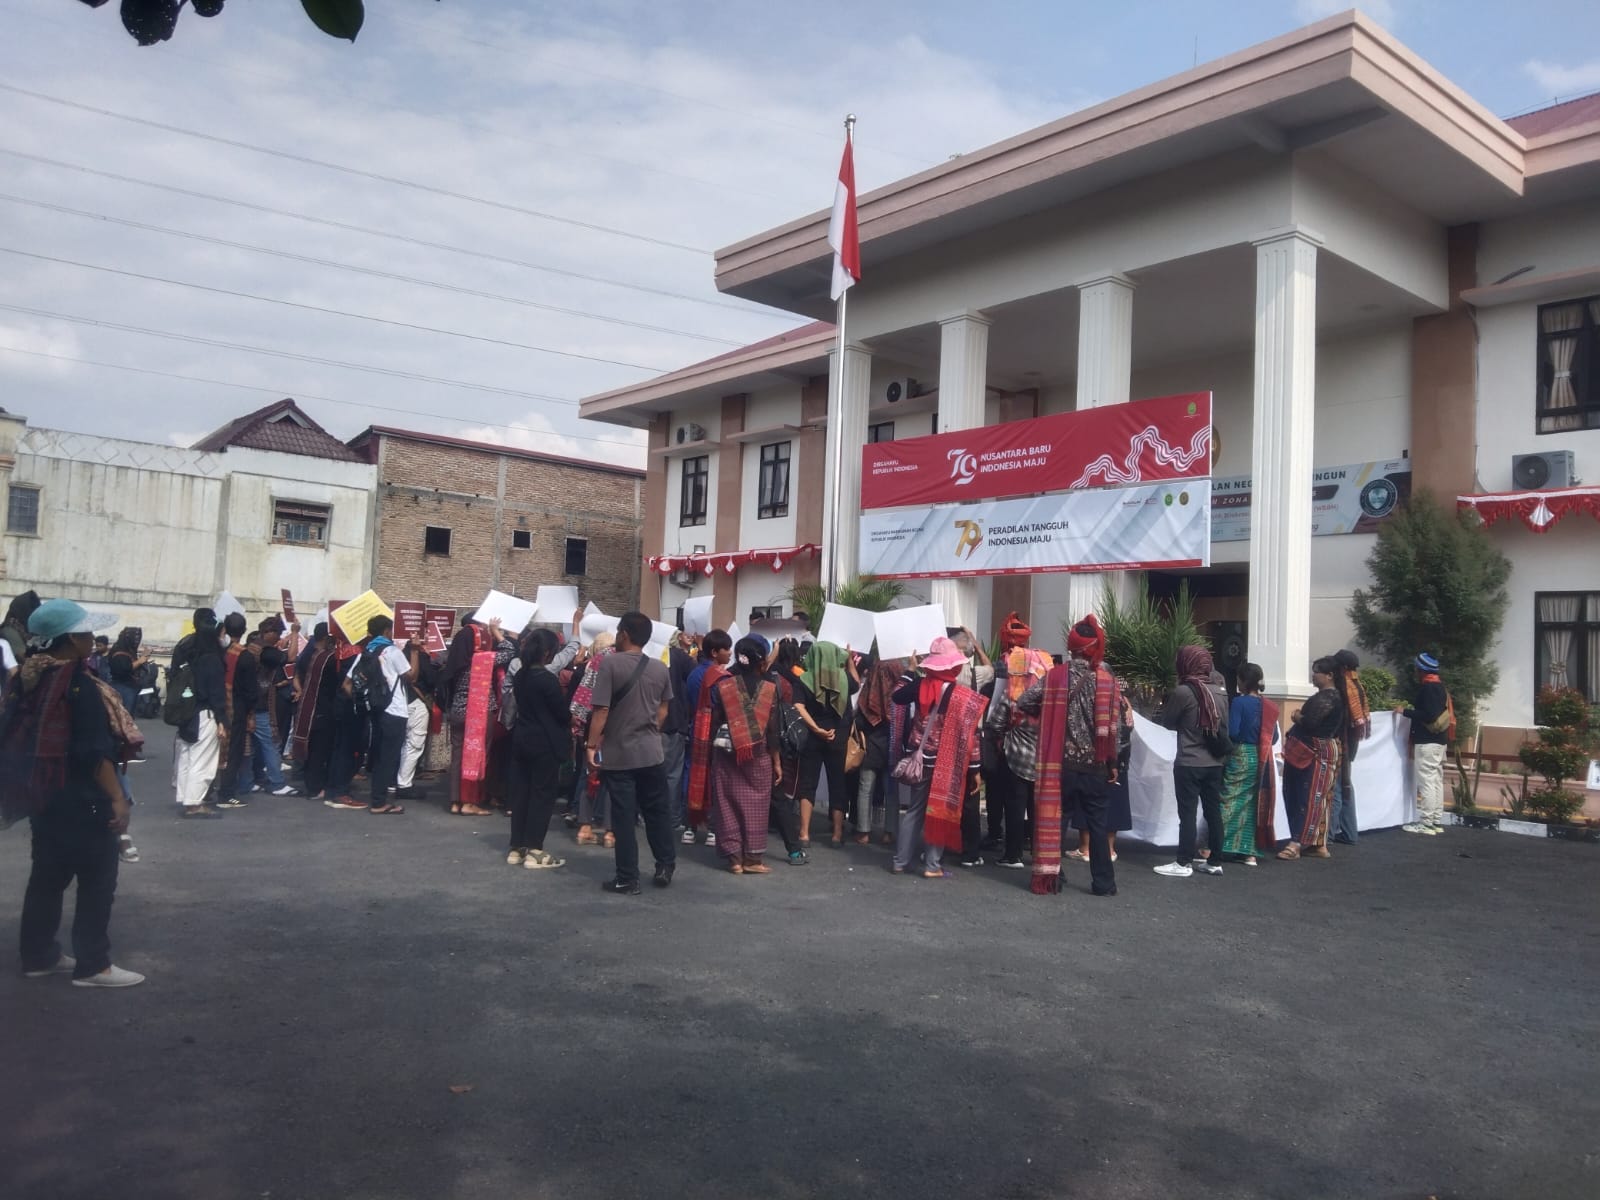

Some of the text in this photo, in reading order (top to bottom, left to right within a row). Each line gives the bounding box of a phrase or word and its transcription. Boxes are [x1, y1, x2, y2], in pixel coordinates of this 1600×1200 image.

[980, 444, 1052, 462] NUSANTARA BARU
[947, 448, 977, 486] 79
[980, 457, 1047, 473] INDONESIA MAJU
[1211, 481, 1231, 491] LAN
[1222, 496, 1248, 505] ZONA
[988, 521, 1069, 536] PERADILAN TANGGUH
[988, 534, 1052, 547] INDONESIA MAJU
